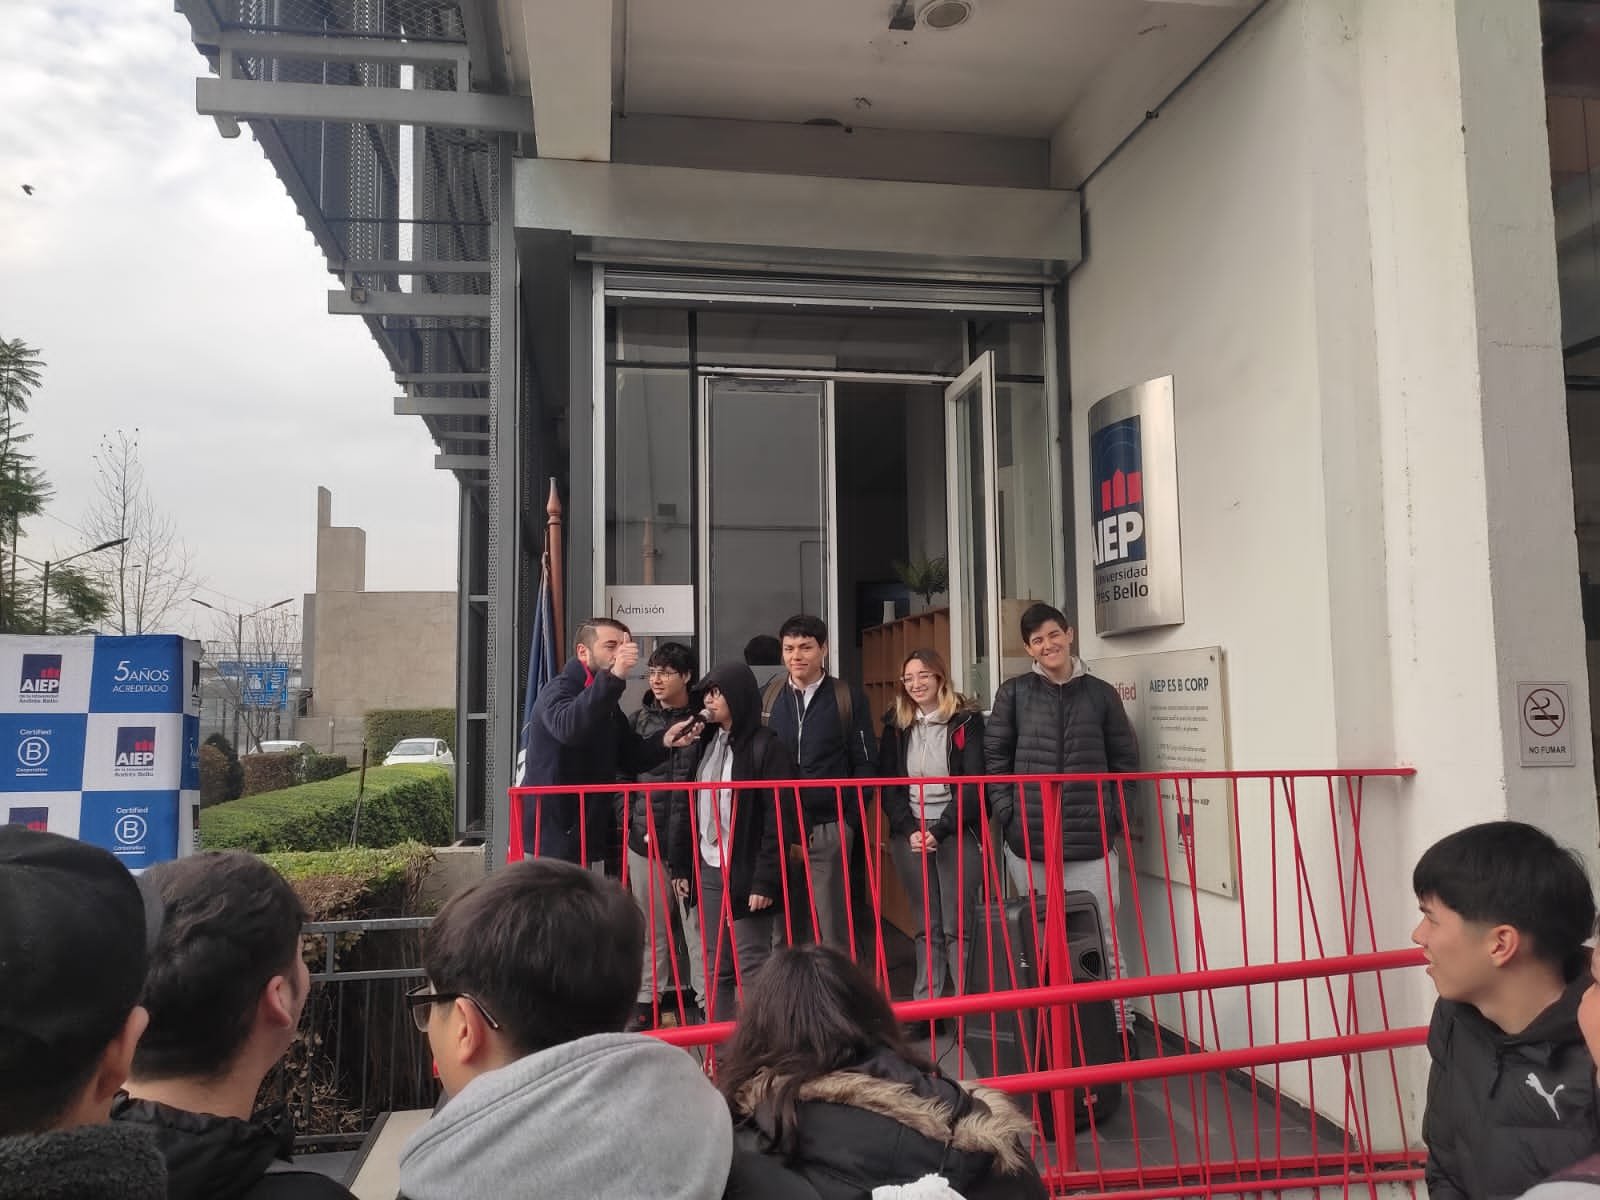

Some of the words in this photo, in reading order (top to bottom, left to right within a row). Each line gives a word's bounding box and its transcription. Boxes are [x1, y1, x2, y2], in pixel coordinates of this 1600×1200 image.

[1113, 581, 1149, 601] Bello
[616, 603, 665, 615] Admisión
[21, 679, 59, 692] AIEP
[112, 684, 169, 693] ACREDITADO
[1150, 679, 1166, 692] AIEP
[1167, 678, 1177, 692] ES
[1184, 677, 1209, 691] CORP
[26, 742, 42, 760] B
[1540, 746, 1567, 754] FUMAR
[116, 752, 154, 766] AIEP
[123, 820, 138, 838] B
